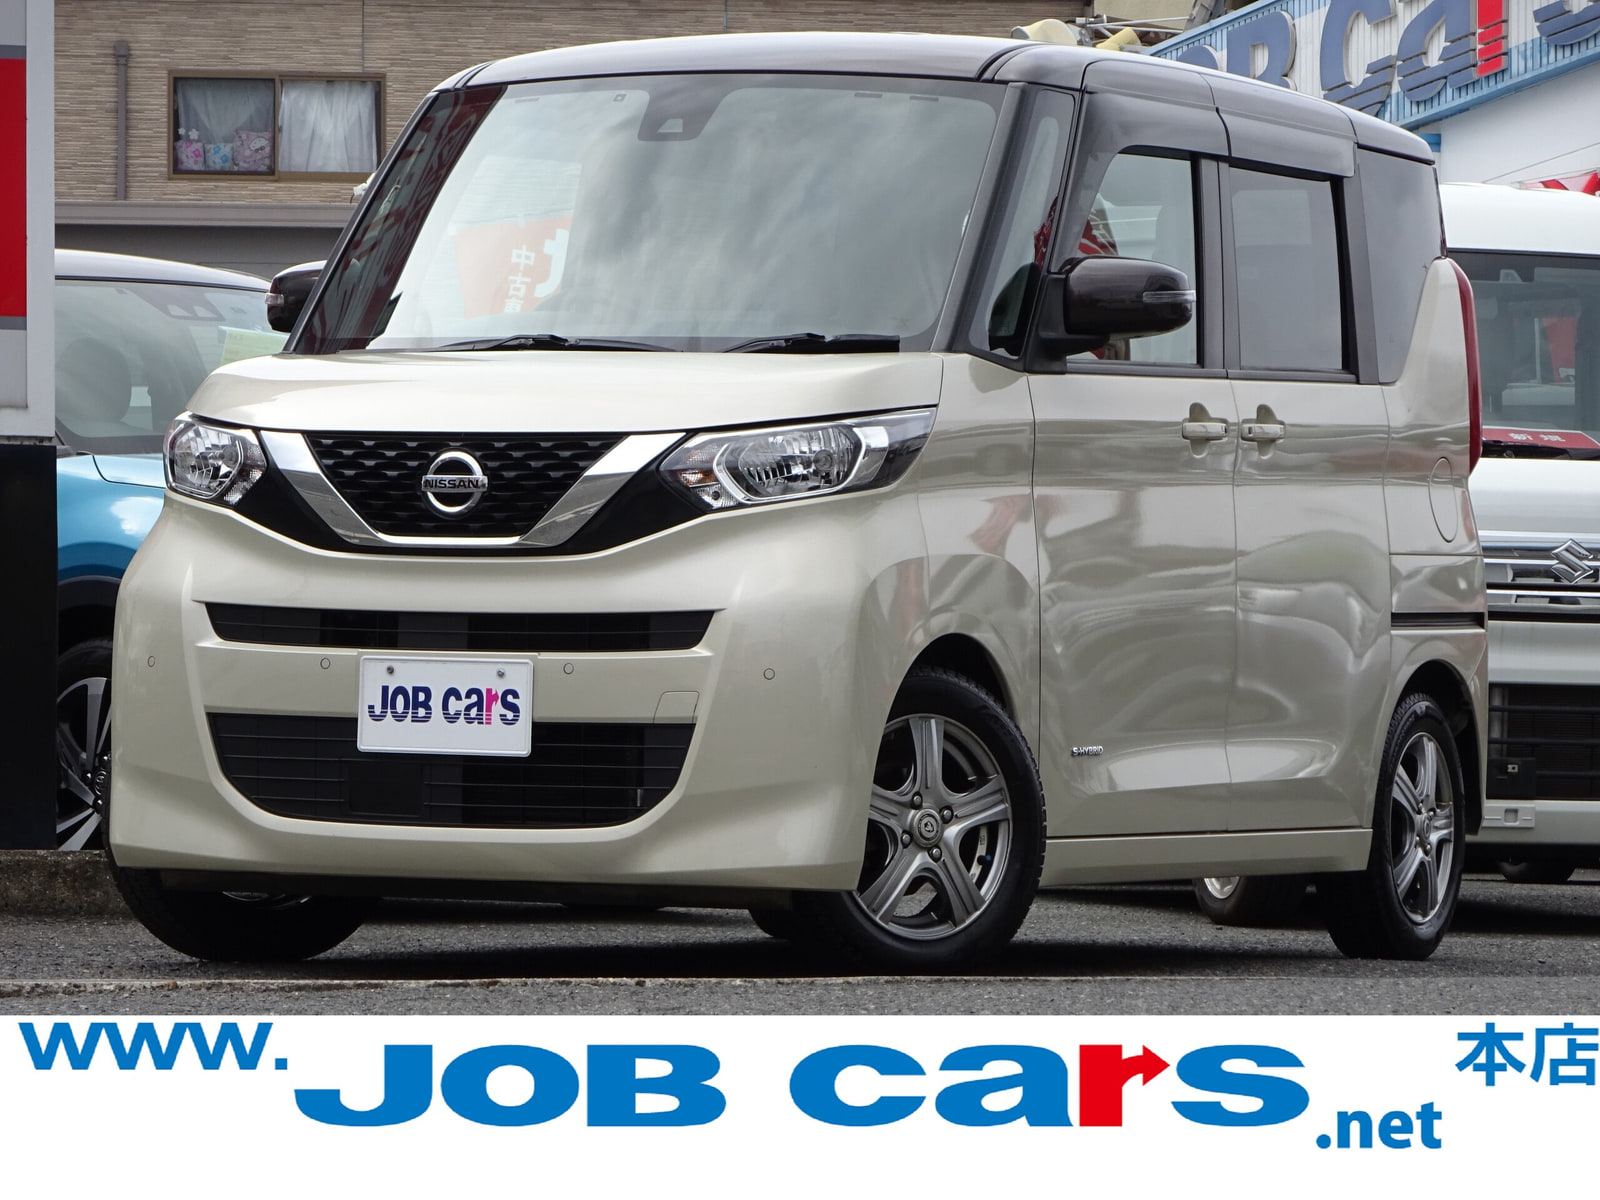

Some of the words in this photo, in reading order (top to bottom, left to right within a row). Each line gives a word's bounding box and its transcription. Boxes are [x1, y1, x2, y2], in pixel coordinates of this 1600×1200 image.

[423, 478, 481, 490] NISSAN
[367, 685, 433, 723] JOB
[442, 687, 521, 726] cars
